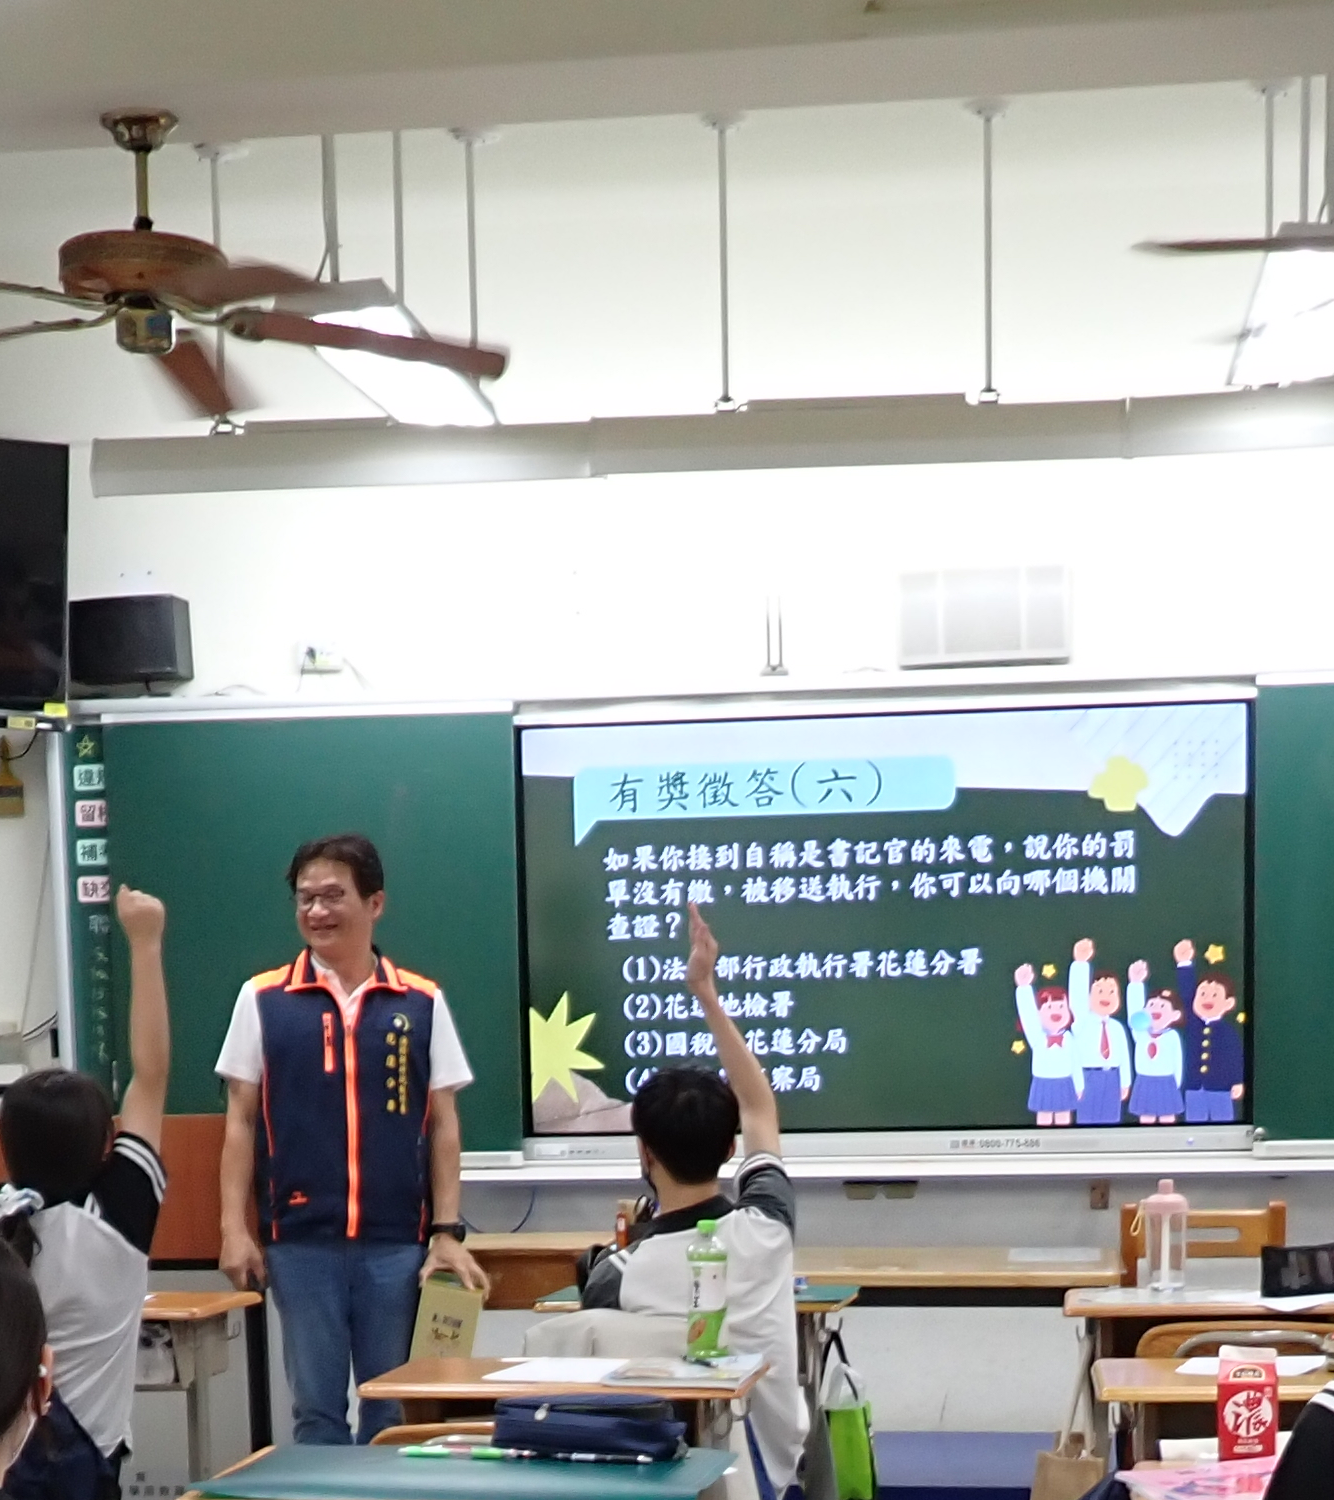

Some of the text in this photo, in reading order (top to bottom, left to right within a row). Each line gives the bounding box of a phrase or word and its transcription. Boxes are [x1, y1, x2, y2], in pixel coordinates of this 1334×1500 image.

[609, 762, 883, 812] 有獎徵答(六)
[622, 947, 983, 984] (1)法部行政執行署花蓮分署
[623, 1028, 848, 1058] (3)國稅花蓮分局
